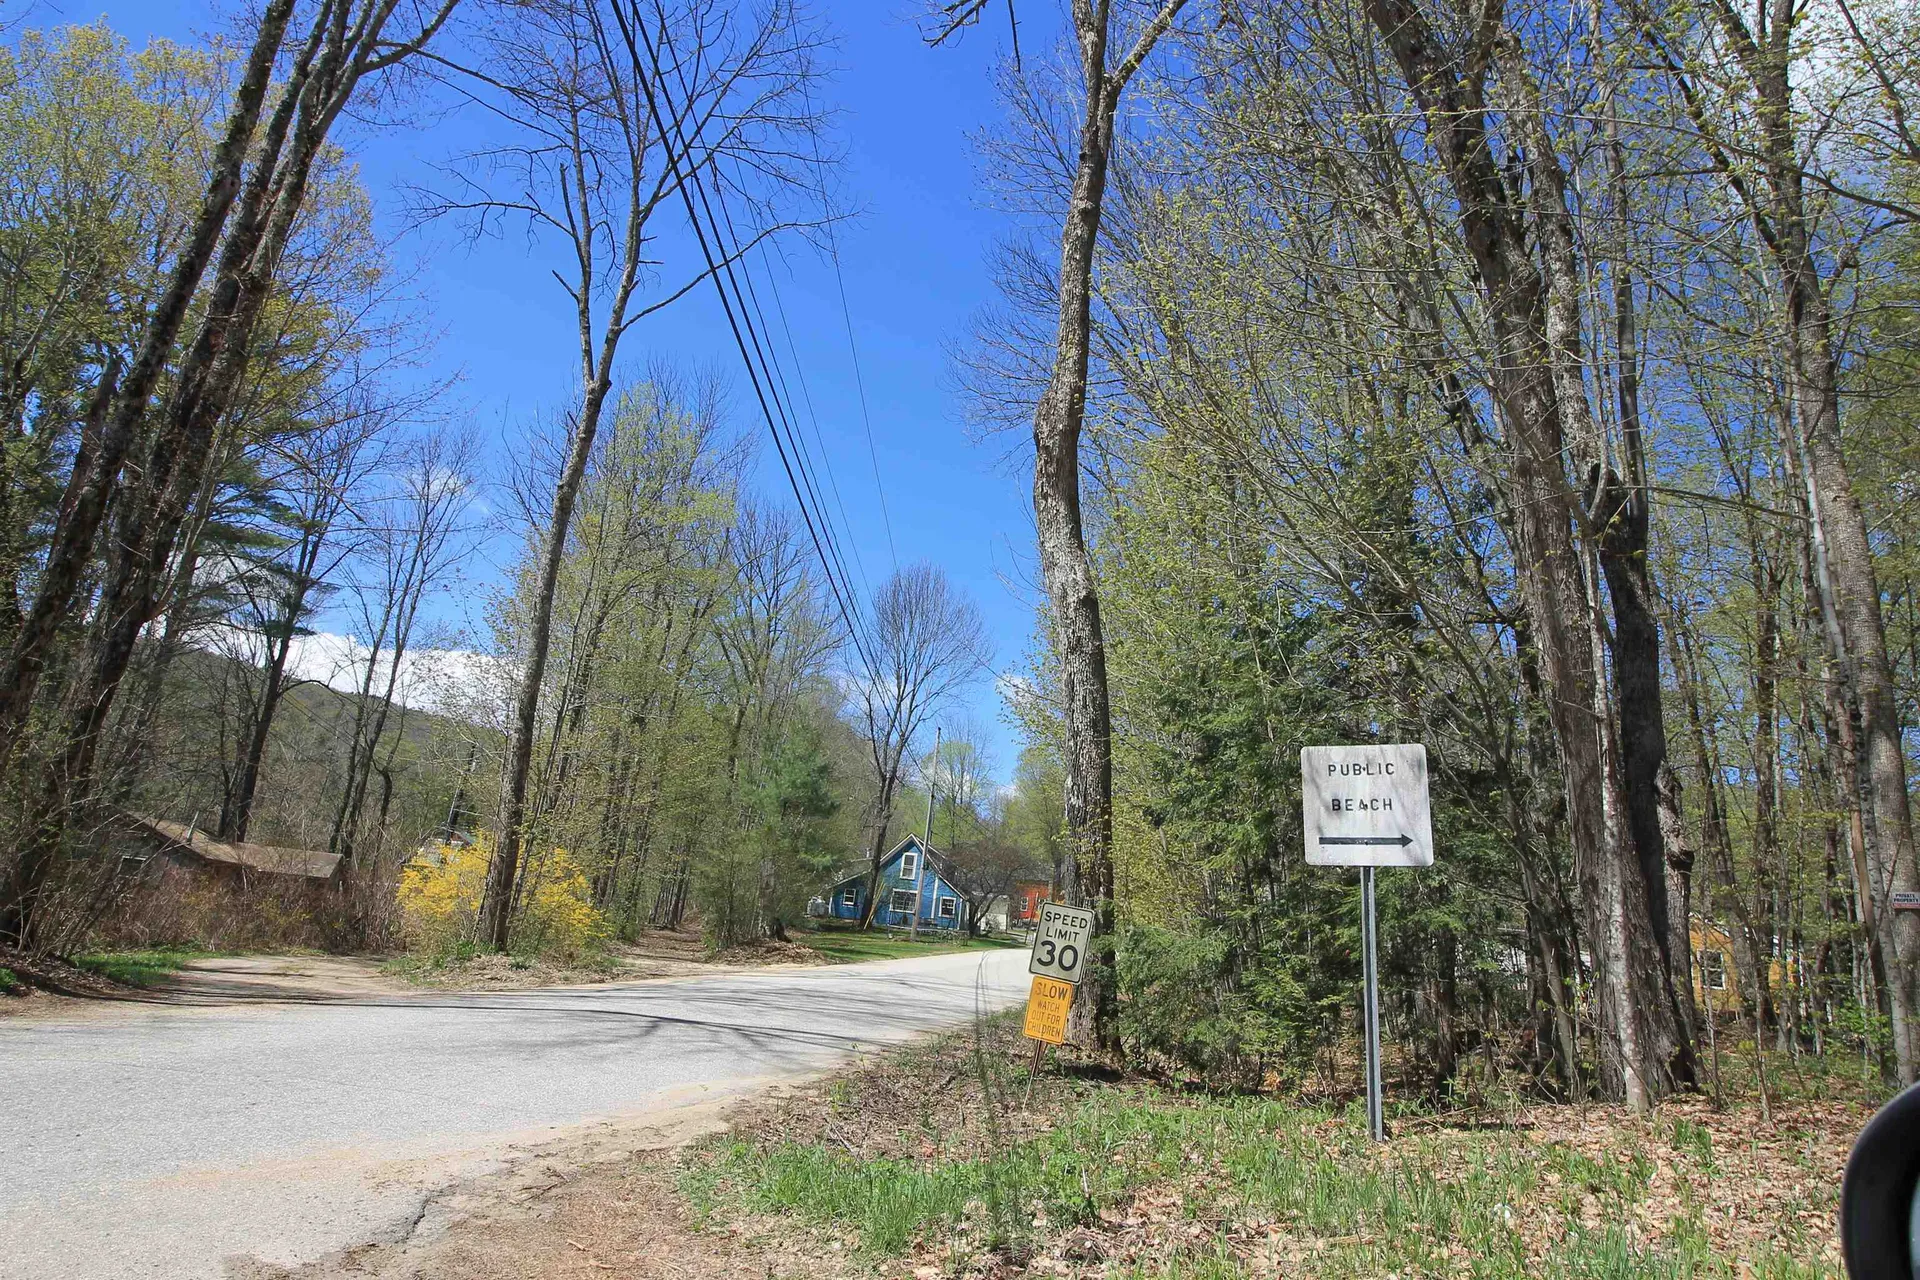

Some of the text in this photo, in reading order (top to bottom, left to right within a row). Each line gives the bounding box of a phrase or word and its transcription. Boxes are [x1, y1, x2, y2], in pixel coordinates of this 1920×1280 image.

[1328, 763, 1395, 776] PUBLIC
[1331, 798, 1393, 812] BEACH
[1044, 911, 1088, 929] SPEED
[1045, 927, 1080, 943] LIMIT
[1036, 940, 1079, 972] 30
[1035, 982, 1069, 1001] SLOW
[1037, 1000, 1060, 1013] WATCH
[1031, 1009, 1061, 1025] OUT FOR
[1027, 1021, 1061, 1038] CHILDREN
